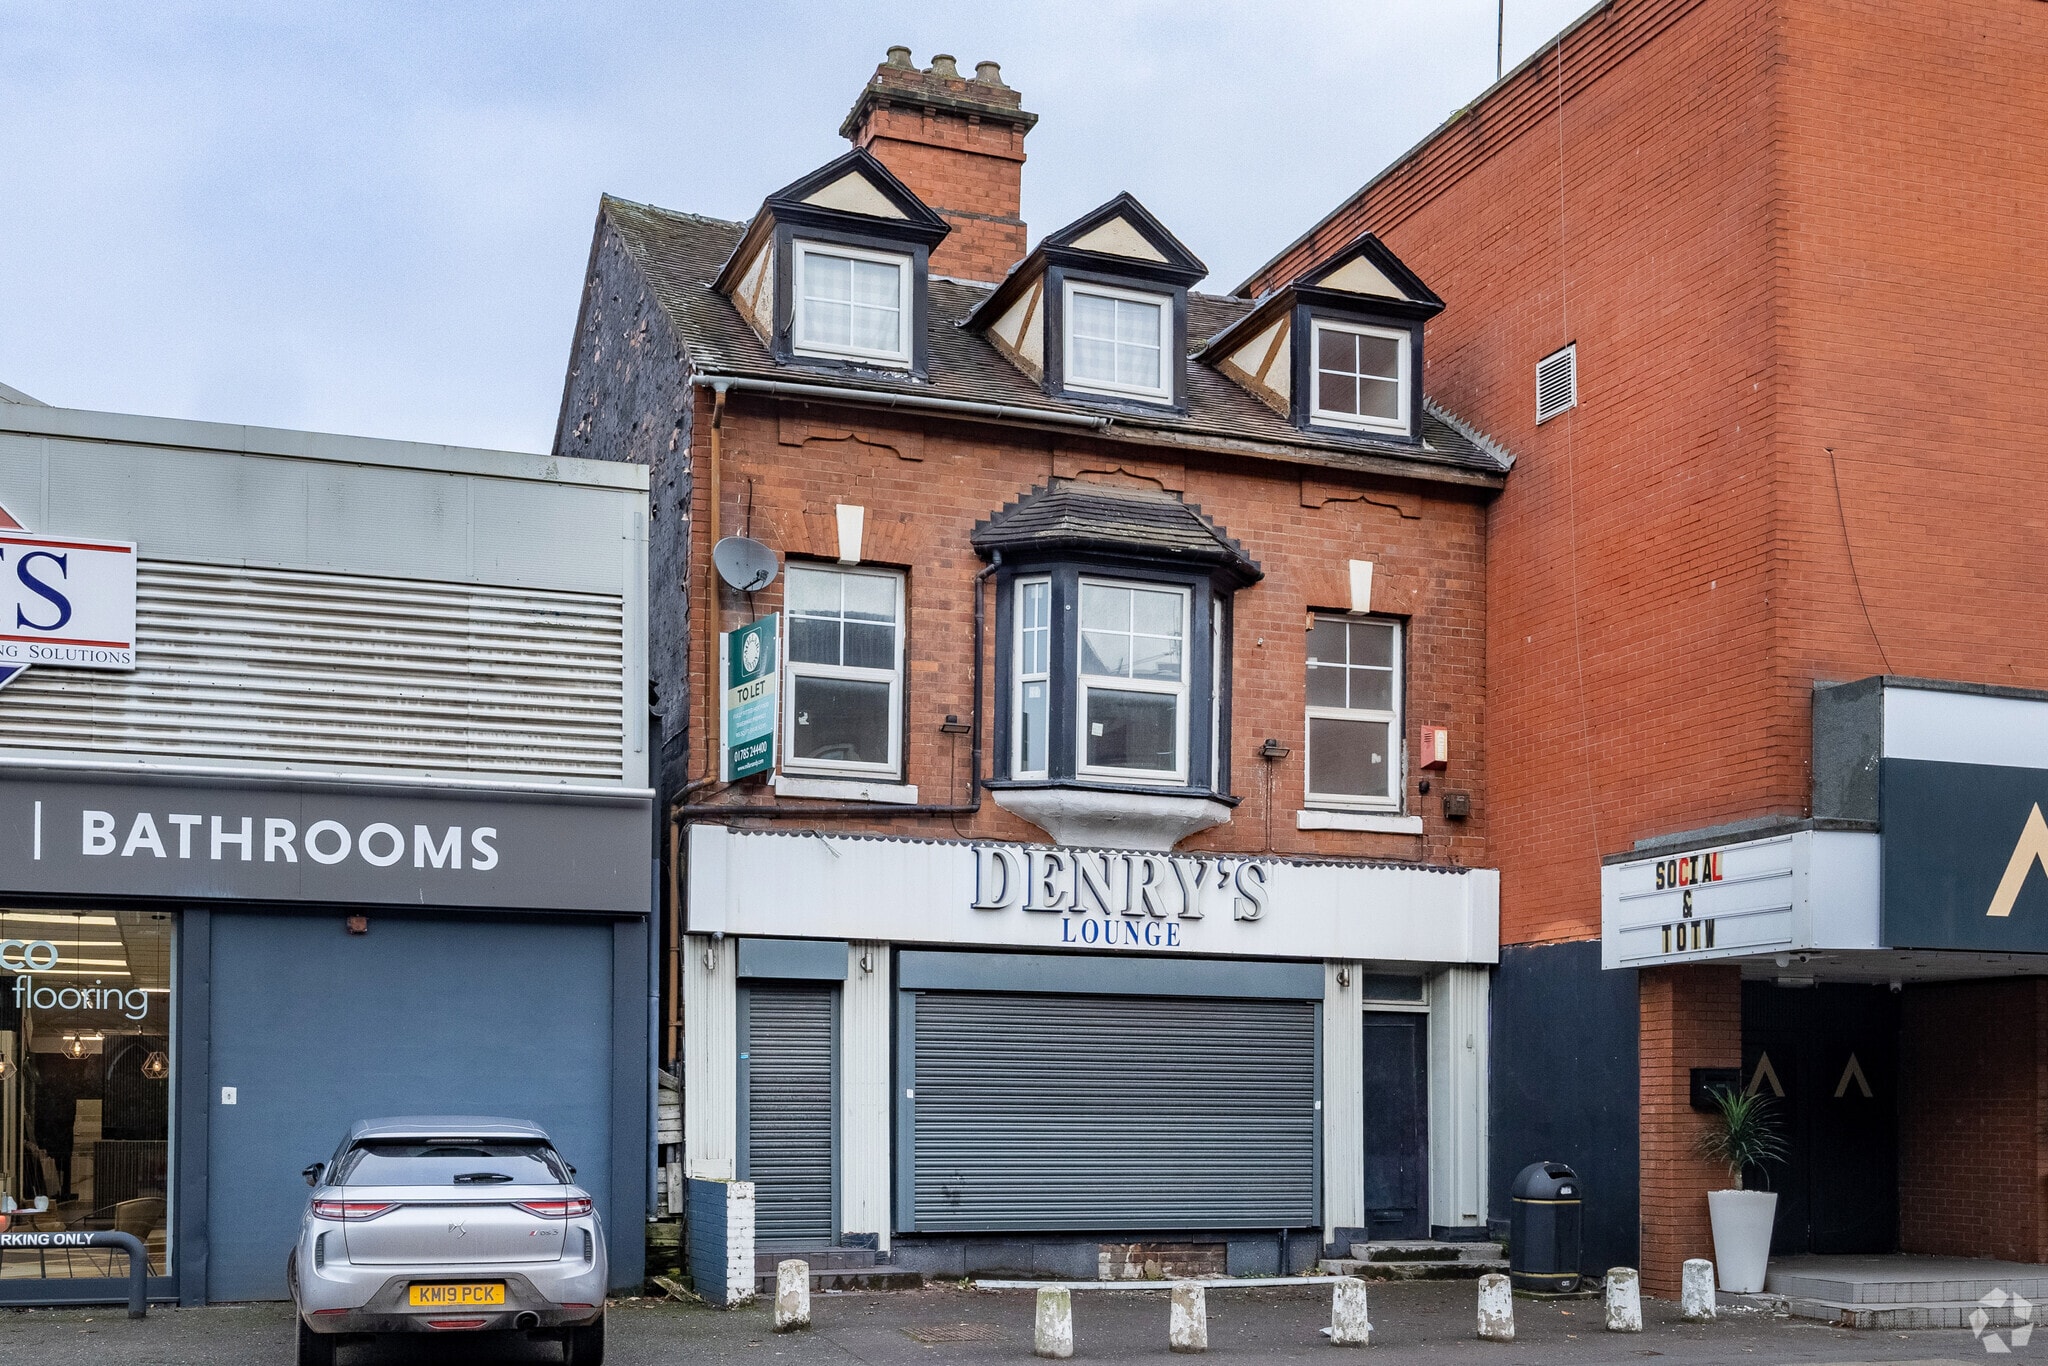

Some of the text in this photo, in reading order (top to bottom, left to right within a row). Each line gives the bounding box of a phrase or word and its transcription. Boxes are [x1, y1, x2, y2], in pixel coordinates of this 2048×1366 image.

[0, 548, 72, 631] S
[29, 645, 131, 664] SOLUTIONS
[737, 680, 766, 703] TO LET
[734, 747, 749, 762] 01785
[82, 810, 499, 871] BATHROOMS
[970, 845, 1270, 921] DENRY'S
[1656, 852, 1723, 890] SOCIAL
[1682, 889, 1693, 918] &
[1062, 917, 1182, 946] LOUNGE
[12, 975, 148, 1020] flooring
[53, 1233, 95, 1245] ONLY
[420, 1286, 494, 1302] KM19 PCK
